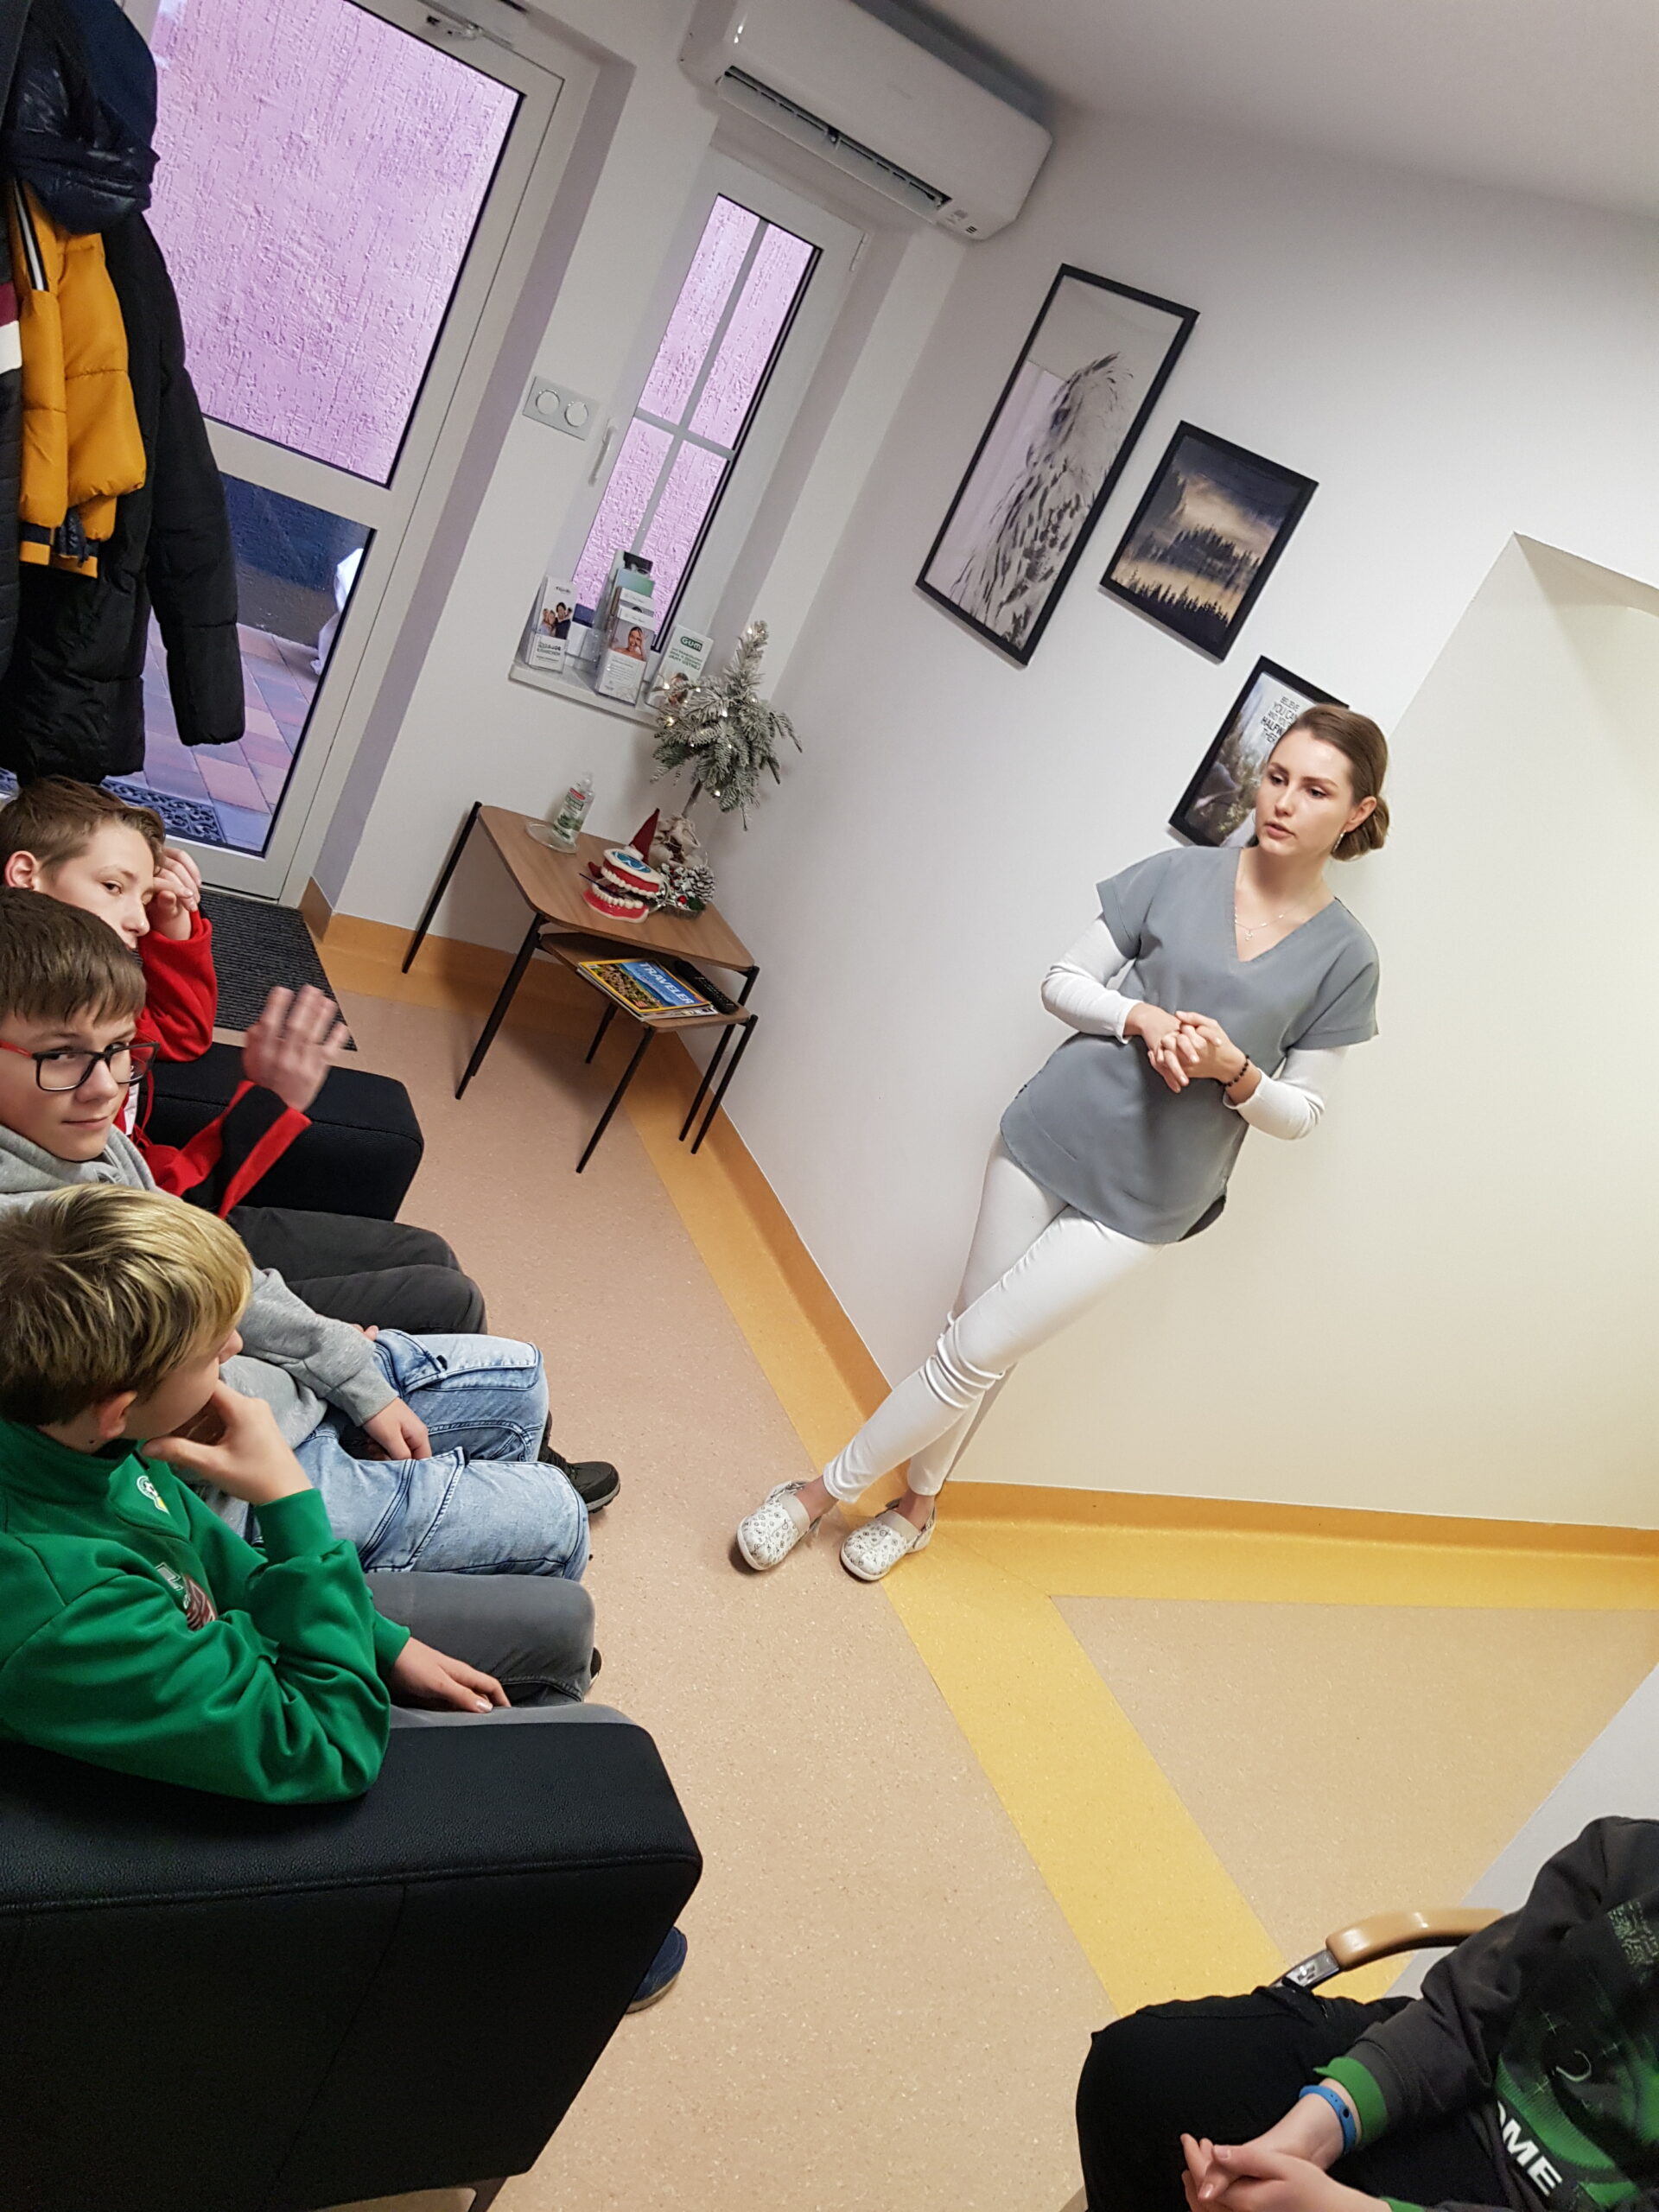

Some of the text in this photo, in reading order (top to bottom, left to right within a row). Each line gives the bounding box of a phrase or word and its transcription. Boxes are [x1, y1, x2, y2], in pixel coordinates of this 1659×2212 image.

[682, 638, 702, 651] GUM
[1272, 702, 1287, 716] YOU
[1263, 728, 1278, 743] THER
[640, 962, 694, 1004] TRAVELER
